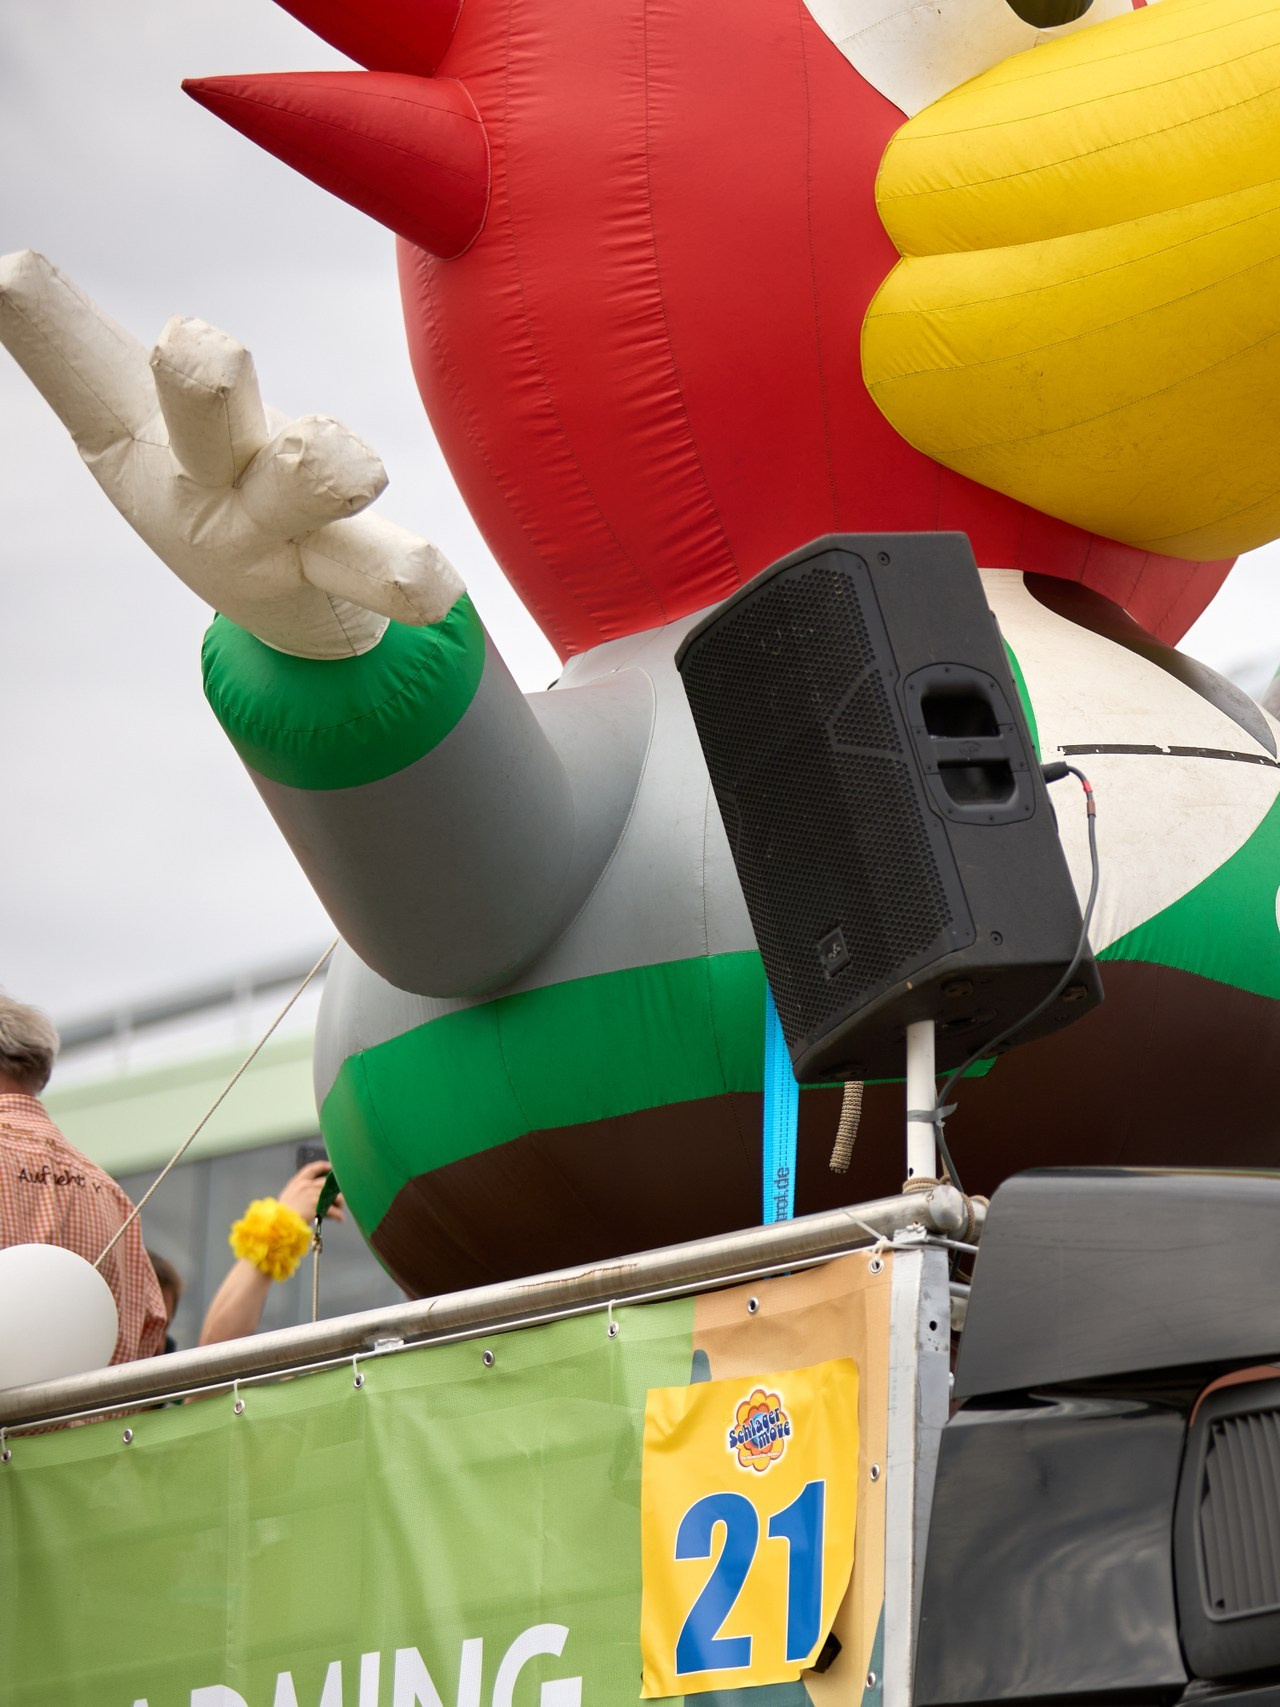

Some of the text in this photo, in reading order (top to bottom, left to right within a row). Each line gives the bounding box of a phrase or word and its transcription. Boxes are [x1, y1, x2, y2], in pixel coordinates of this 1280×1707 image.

[18, 1165, 51, 1185] Auf
[729, 1407, 780, 1449] Schlager
[674, 1479, 827, 1676] 21
[130, 1622, 584, 1707] MING
